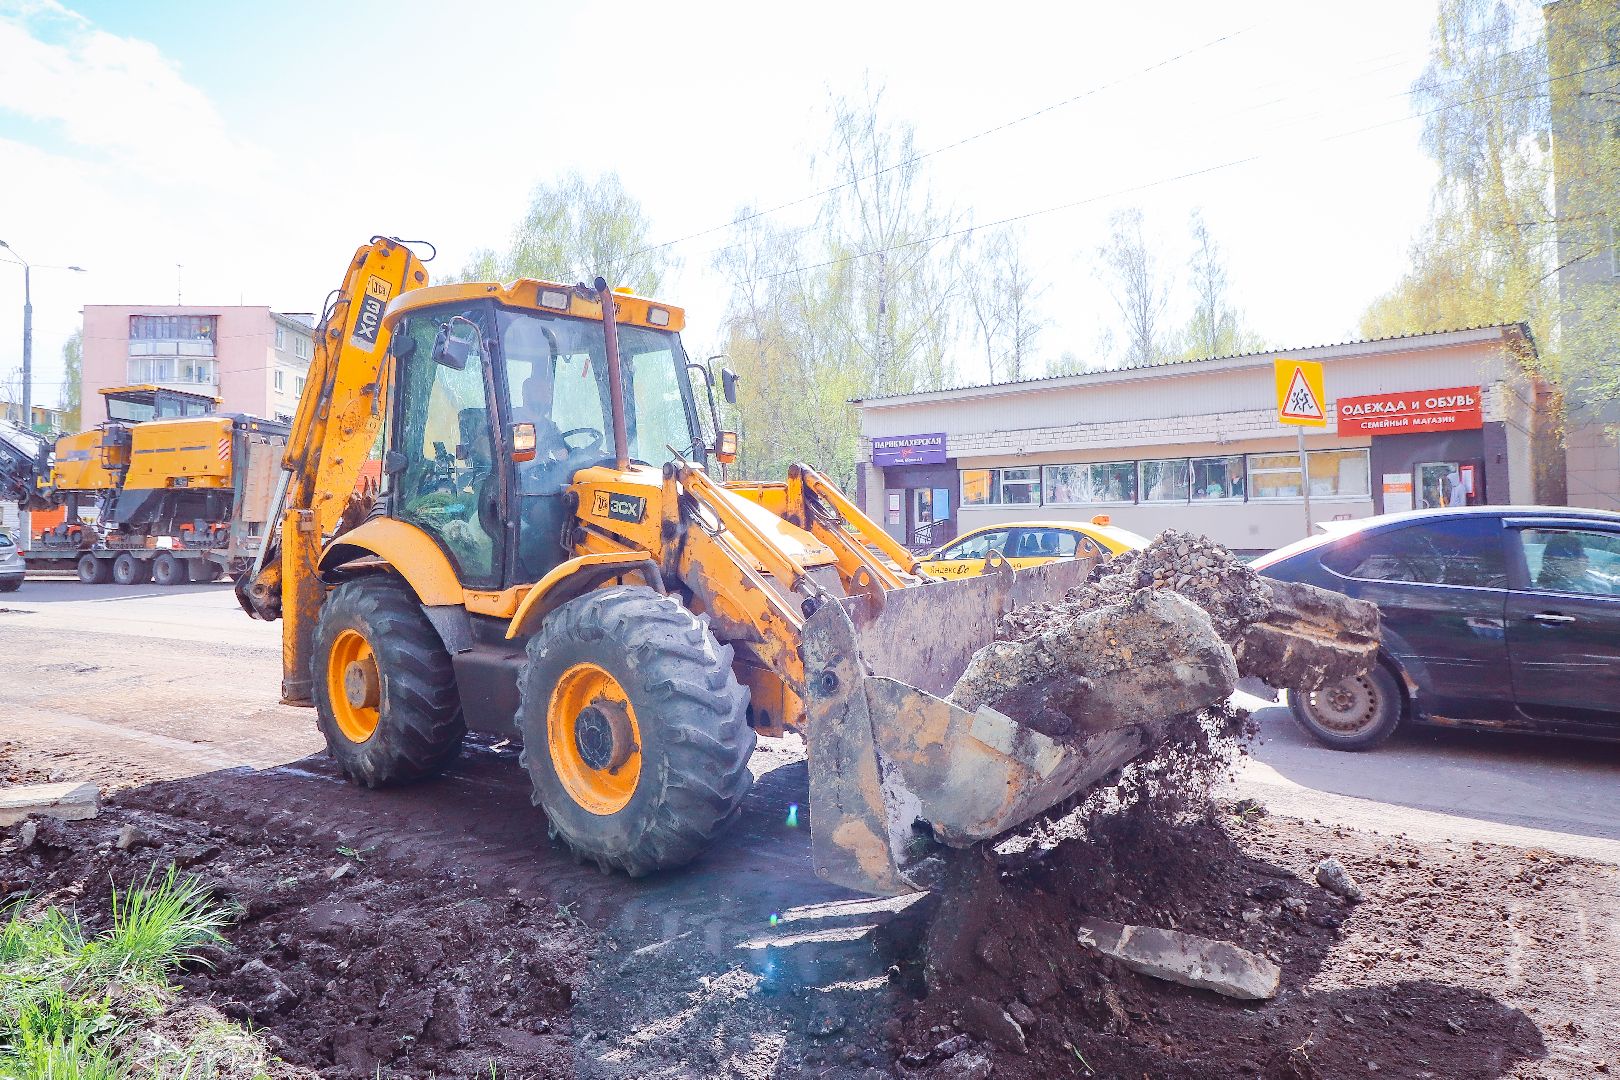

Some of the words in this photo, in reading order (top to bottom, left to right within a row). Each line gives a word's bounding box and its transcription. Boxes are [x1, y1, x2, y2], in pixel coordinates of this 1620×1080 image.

[358, 299, 381, 339] 3CX
[1341, 400, 1407, 416] ОДЕЖДА
[1425, 394, 1475, 409] ОБУВЬ
[1360, 418, 1409, 429] СЕМЕЙНЫЙ
[1412, 416, 1456, 426] МАГАЗИН
[874, 437, 942, 449] ПАРИКМАХЕРСКАЯ
[610, 500, 638, 517] 3CX
[930, 565, 956, 574] Яндекс
